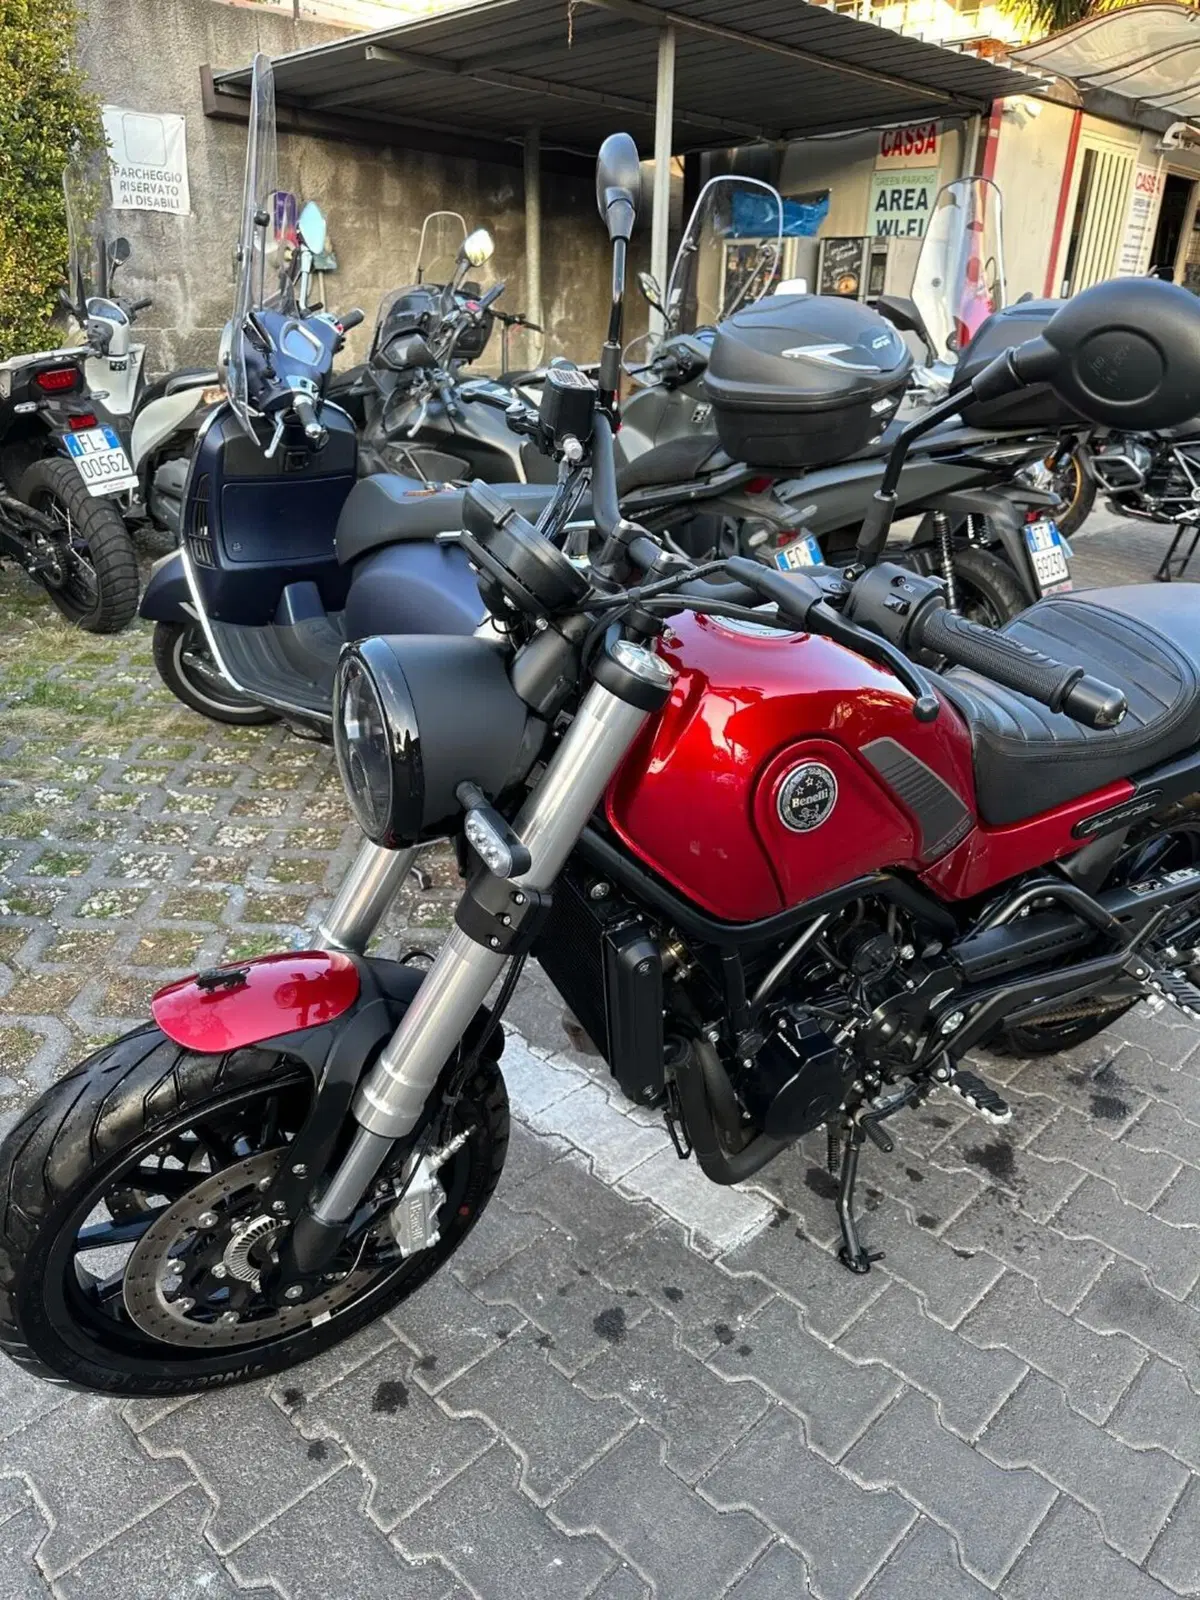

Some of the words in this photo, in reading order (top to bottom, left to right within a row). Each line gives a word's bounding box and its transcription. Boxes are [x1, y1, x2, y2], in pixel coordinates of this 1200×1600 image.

[881, 123, 937, 157] CASSA
[113, 167, 182, 184] PARCHEGGIO
[119, 180, 179, 196] RISERVATO
[121, 194, 133, 206] AI
[136, 196, 180, 209] DISABILI
[875, 187, 929, 212] AREA
[77, 433, 101, 453] FL
[80, 452, 129, 479] 00562
[792, 788, 829, 809] Benelli
